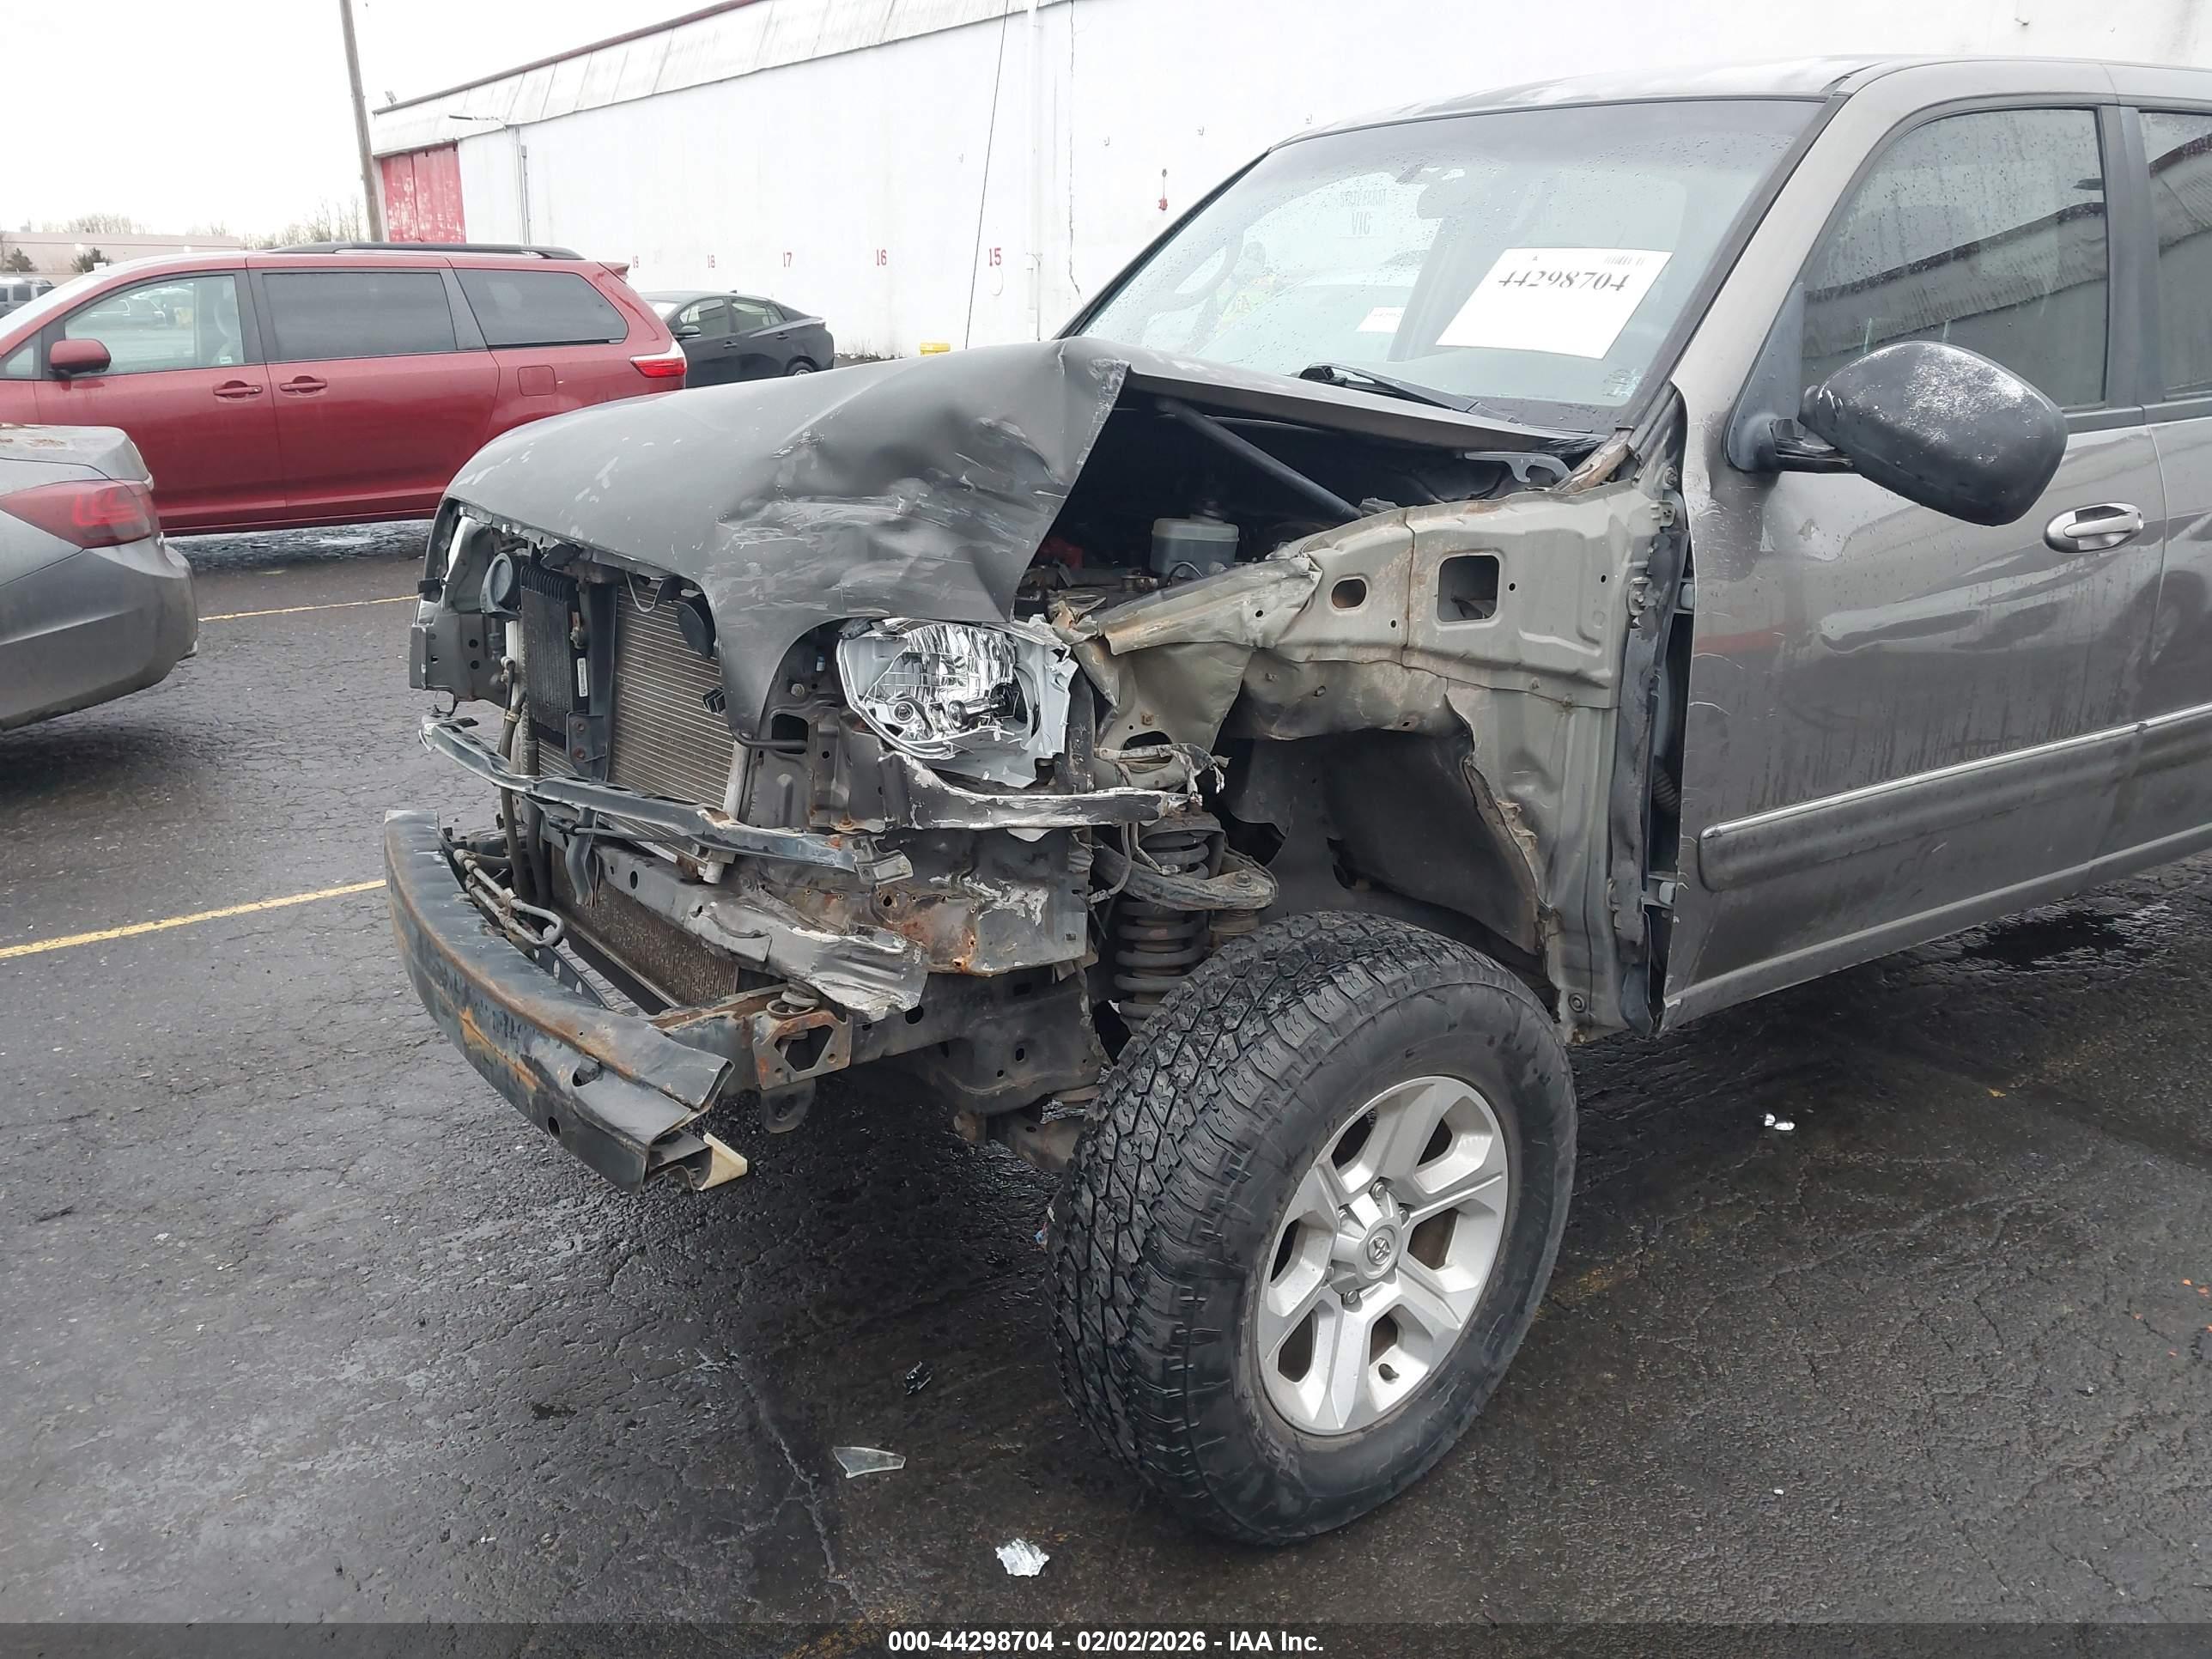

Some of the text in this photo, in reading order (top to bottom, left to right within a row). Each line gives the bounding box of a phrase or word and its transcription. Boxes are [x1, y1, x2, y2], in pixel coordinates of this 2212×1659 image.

[707, 253, 715, 269] 18
[782, 252, 793, 268] 17
[876, 249, 887, 266] 16
[988, 247, 1002, 267] 15
[1498, 270, 1631, 291] 44298704
